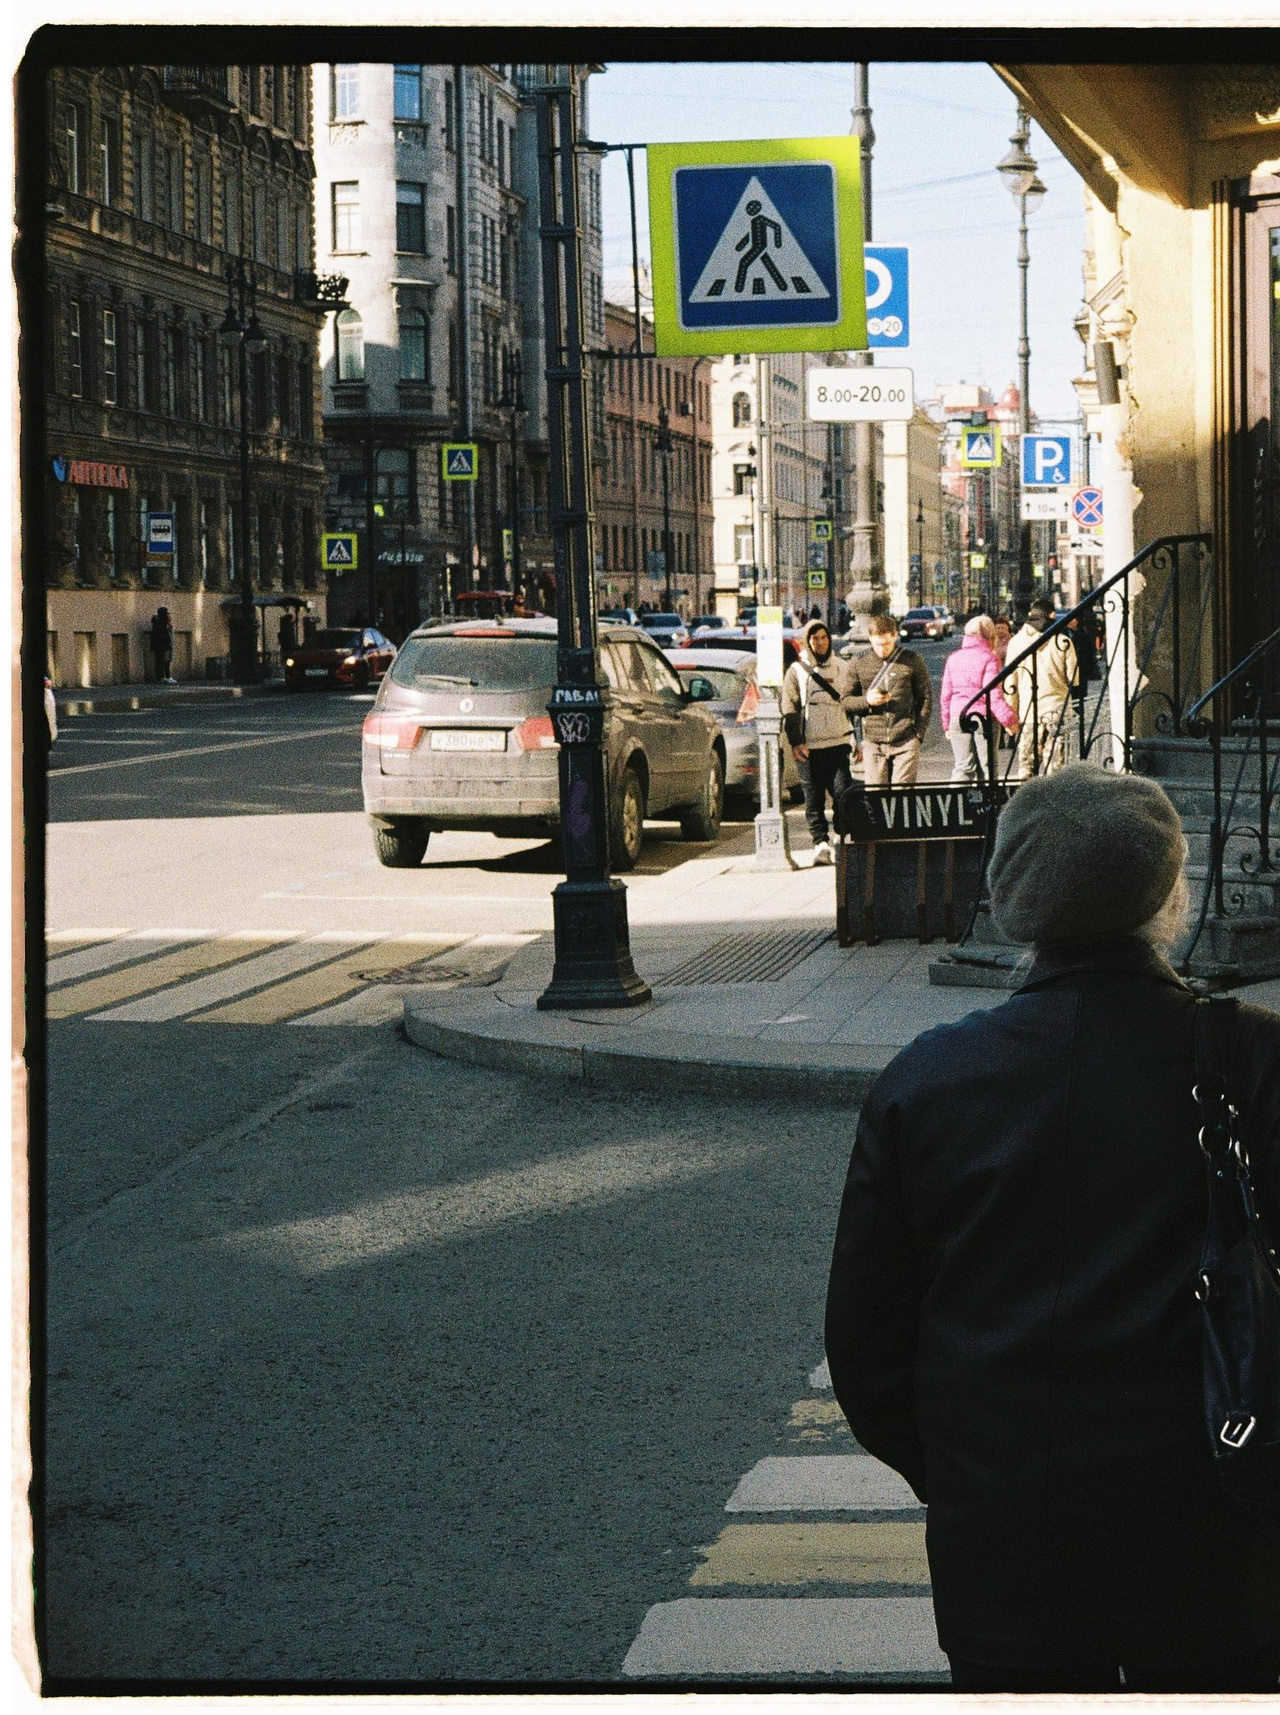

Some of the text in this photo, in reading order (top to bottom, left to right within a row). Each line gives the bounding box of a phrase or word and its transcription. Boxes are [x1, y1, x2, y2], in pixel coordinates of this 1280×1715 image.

[885, 320, 900, 333] 20
[817, 385, 906, 404] 8.00-20.00
[68, 460, 129, 489] АПТЕКА
[1035, 440, 1064, 481] P
[881, 793, 973, 829] VINYL
